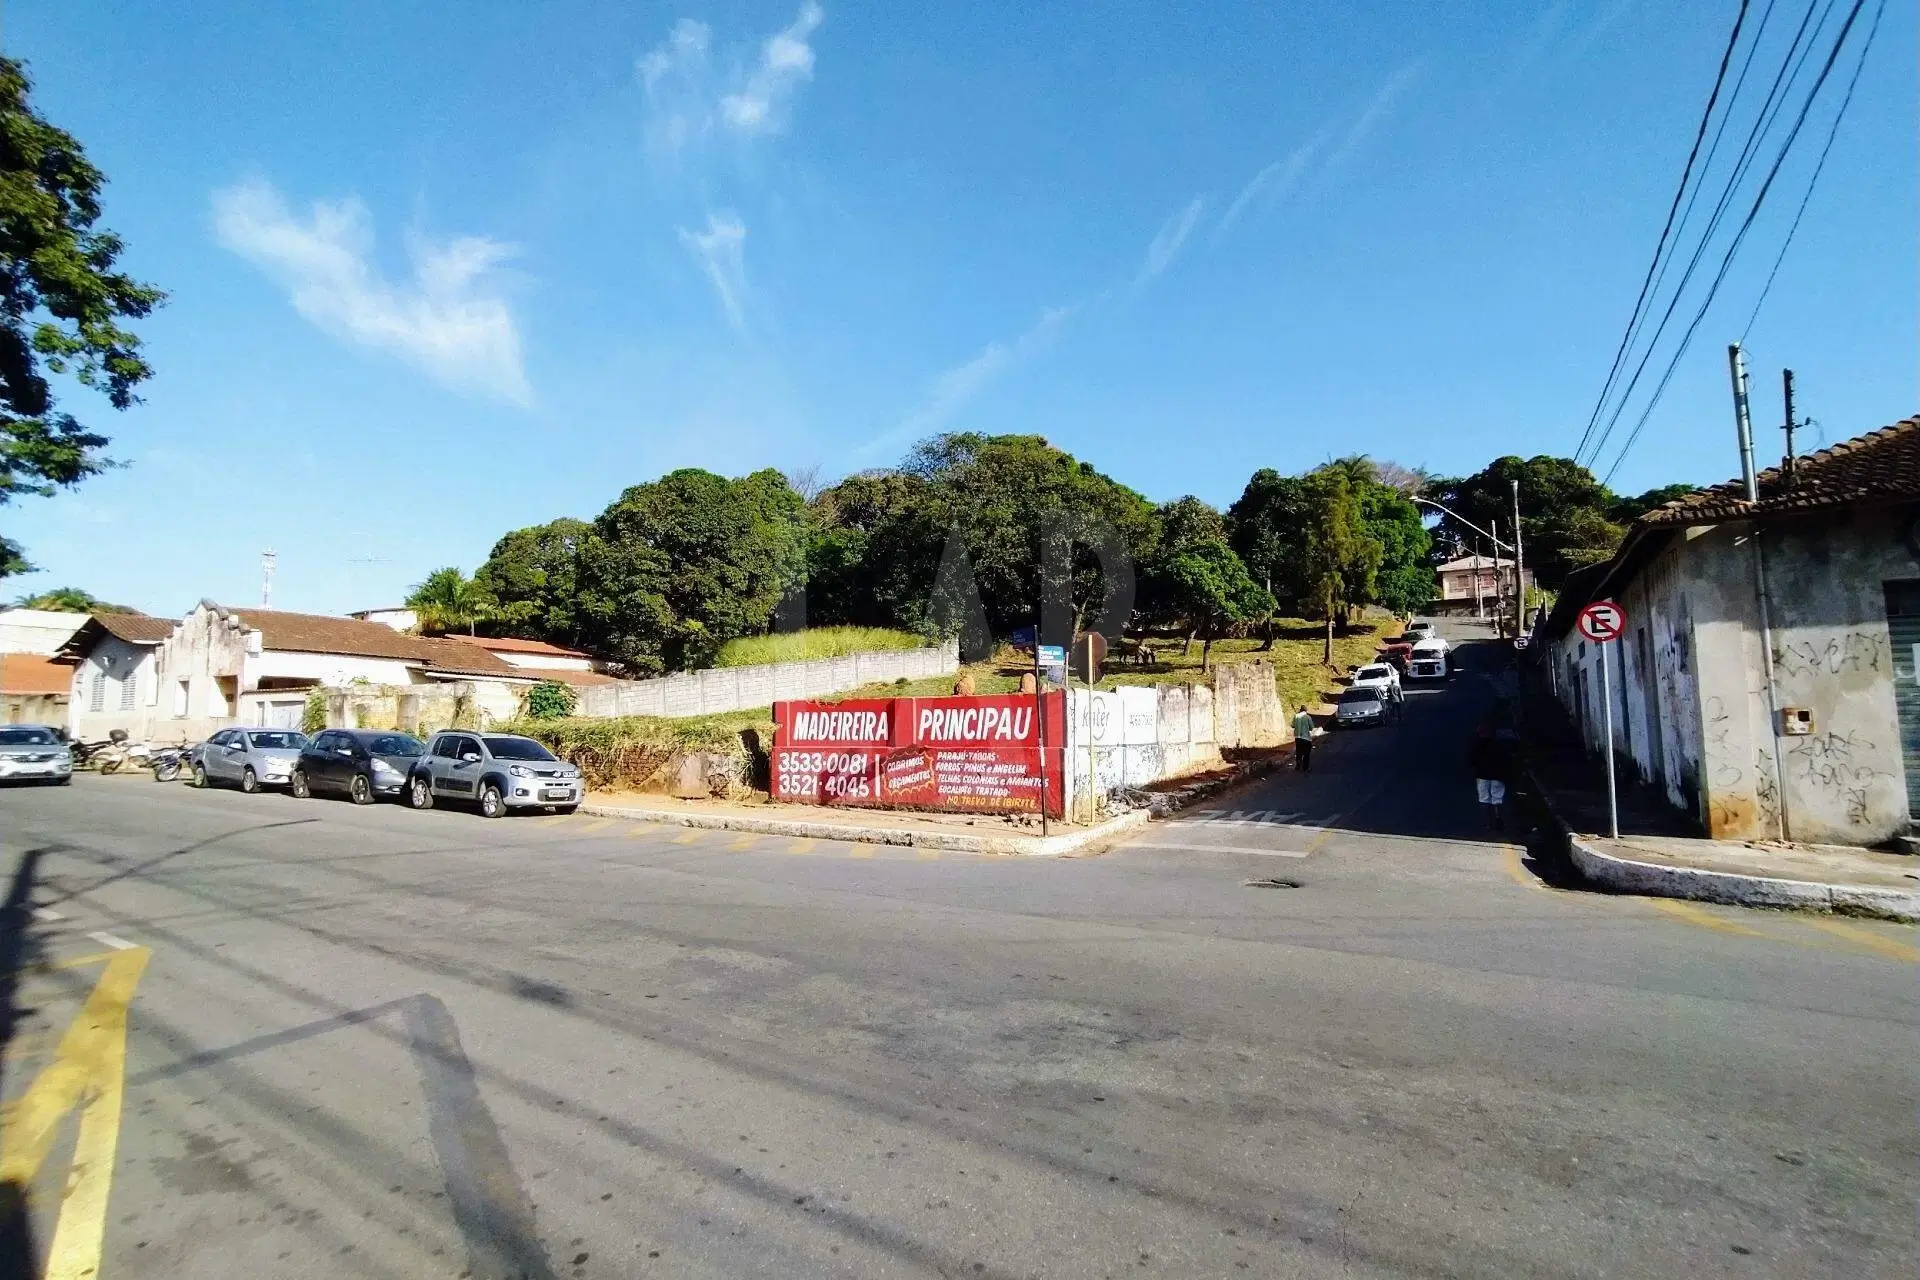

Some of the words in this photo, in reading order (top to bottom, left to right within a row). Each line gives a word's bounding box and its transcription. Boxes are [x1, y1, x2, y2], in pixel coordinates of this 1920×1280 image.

[1591, 610, 1611, 633] E
[793, 711, 889, 741] MADEIREIRA
[918, 706, 1032, 741] PRINCIPAU
[887, 756, 925, 773] COBRIMOS
[938, 774, 962, 784] TELHAS
[947, 796, 959, 804] NO
[962, 796, 986, 806] TREVO
[990, 798, 1001, 806] DE
